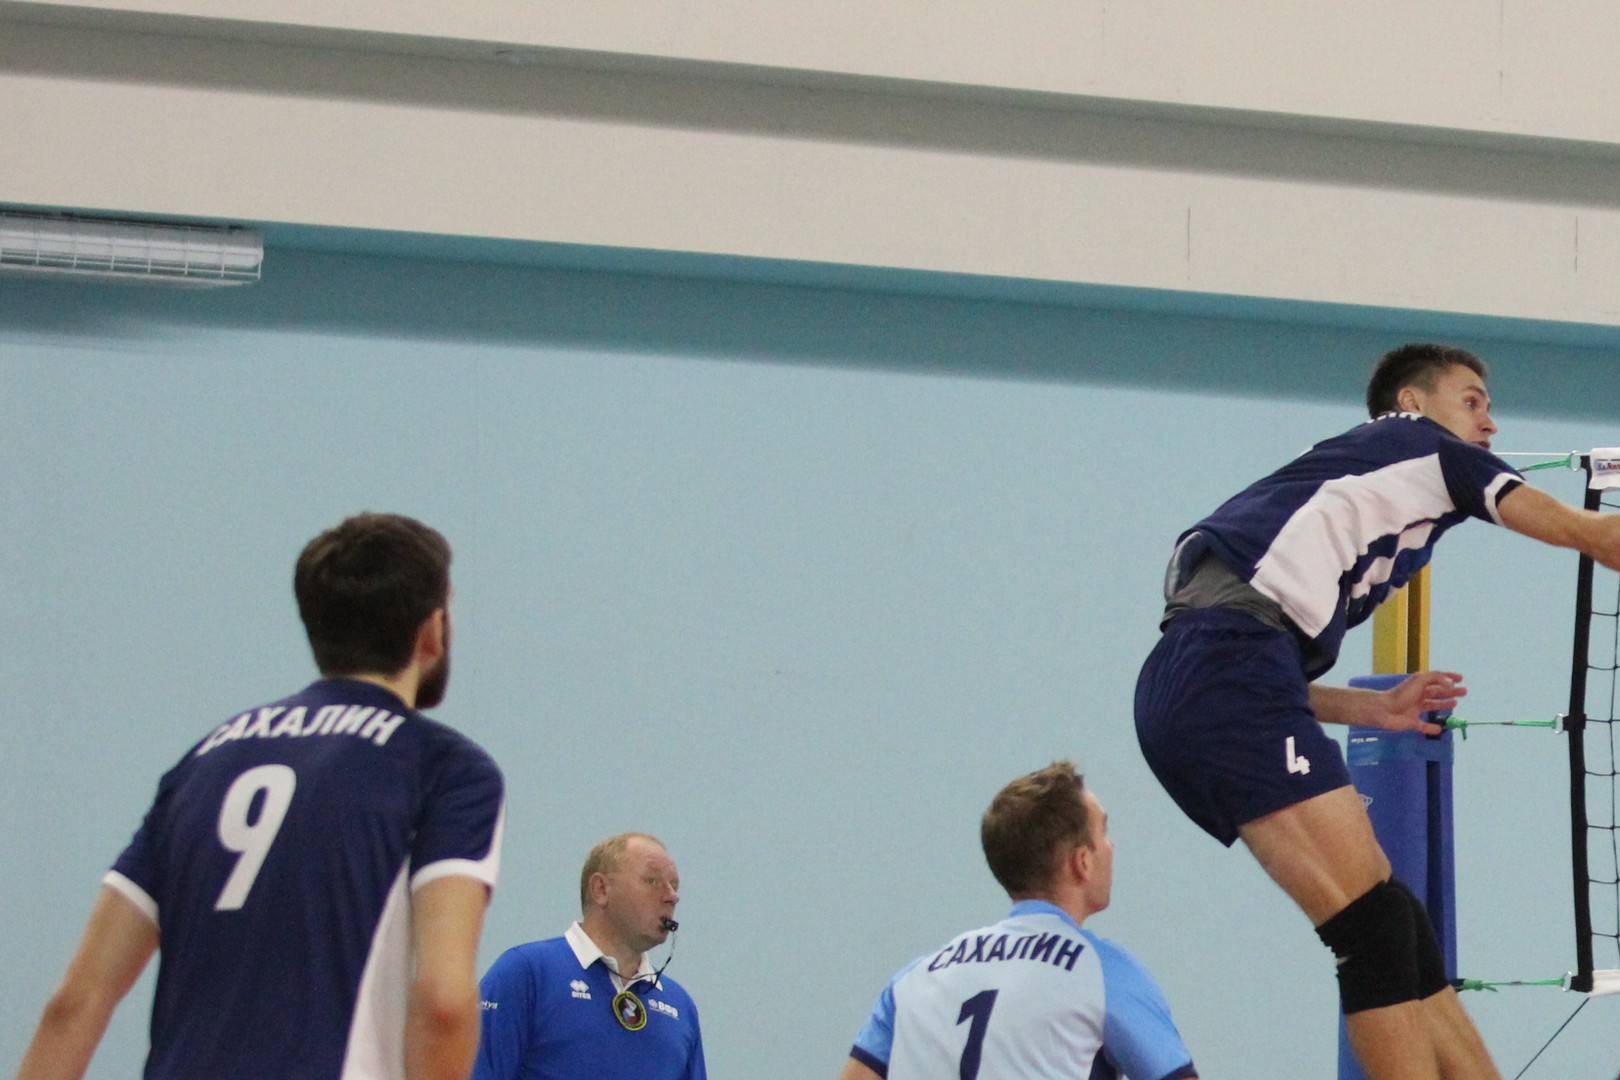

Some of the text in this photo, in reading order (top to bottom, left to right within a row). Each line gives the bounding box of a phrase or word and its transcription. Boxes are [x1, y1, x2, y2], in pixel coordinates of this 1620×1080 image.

[1285, 736, 1311, 775] 4
[214, 764, 297, 912] 9
[928, 931, 1085, 972] САХАЛИН
